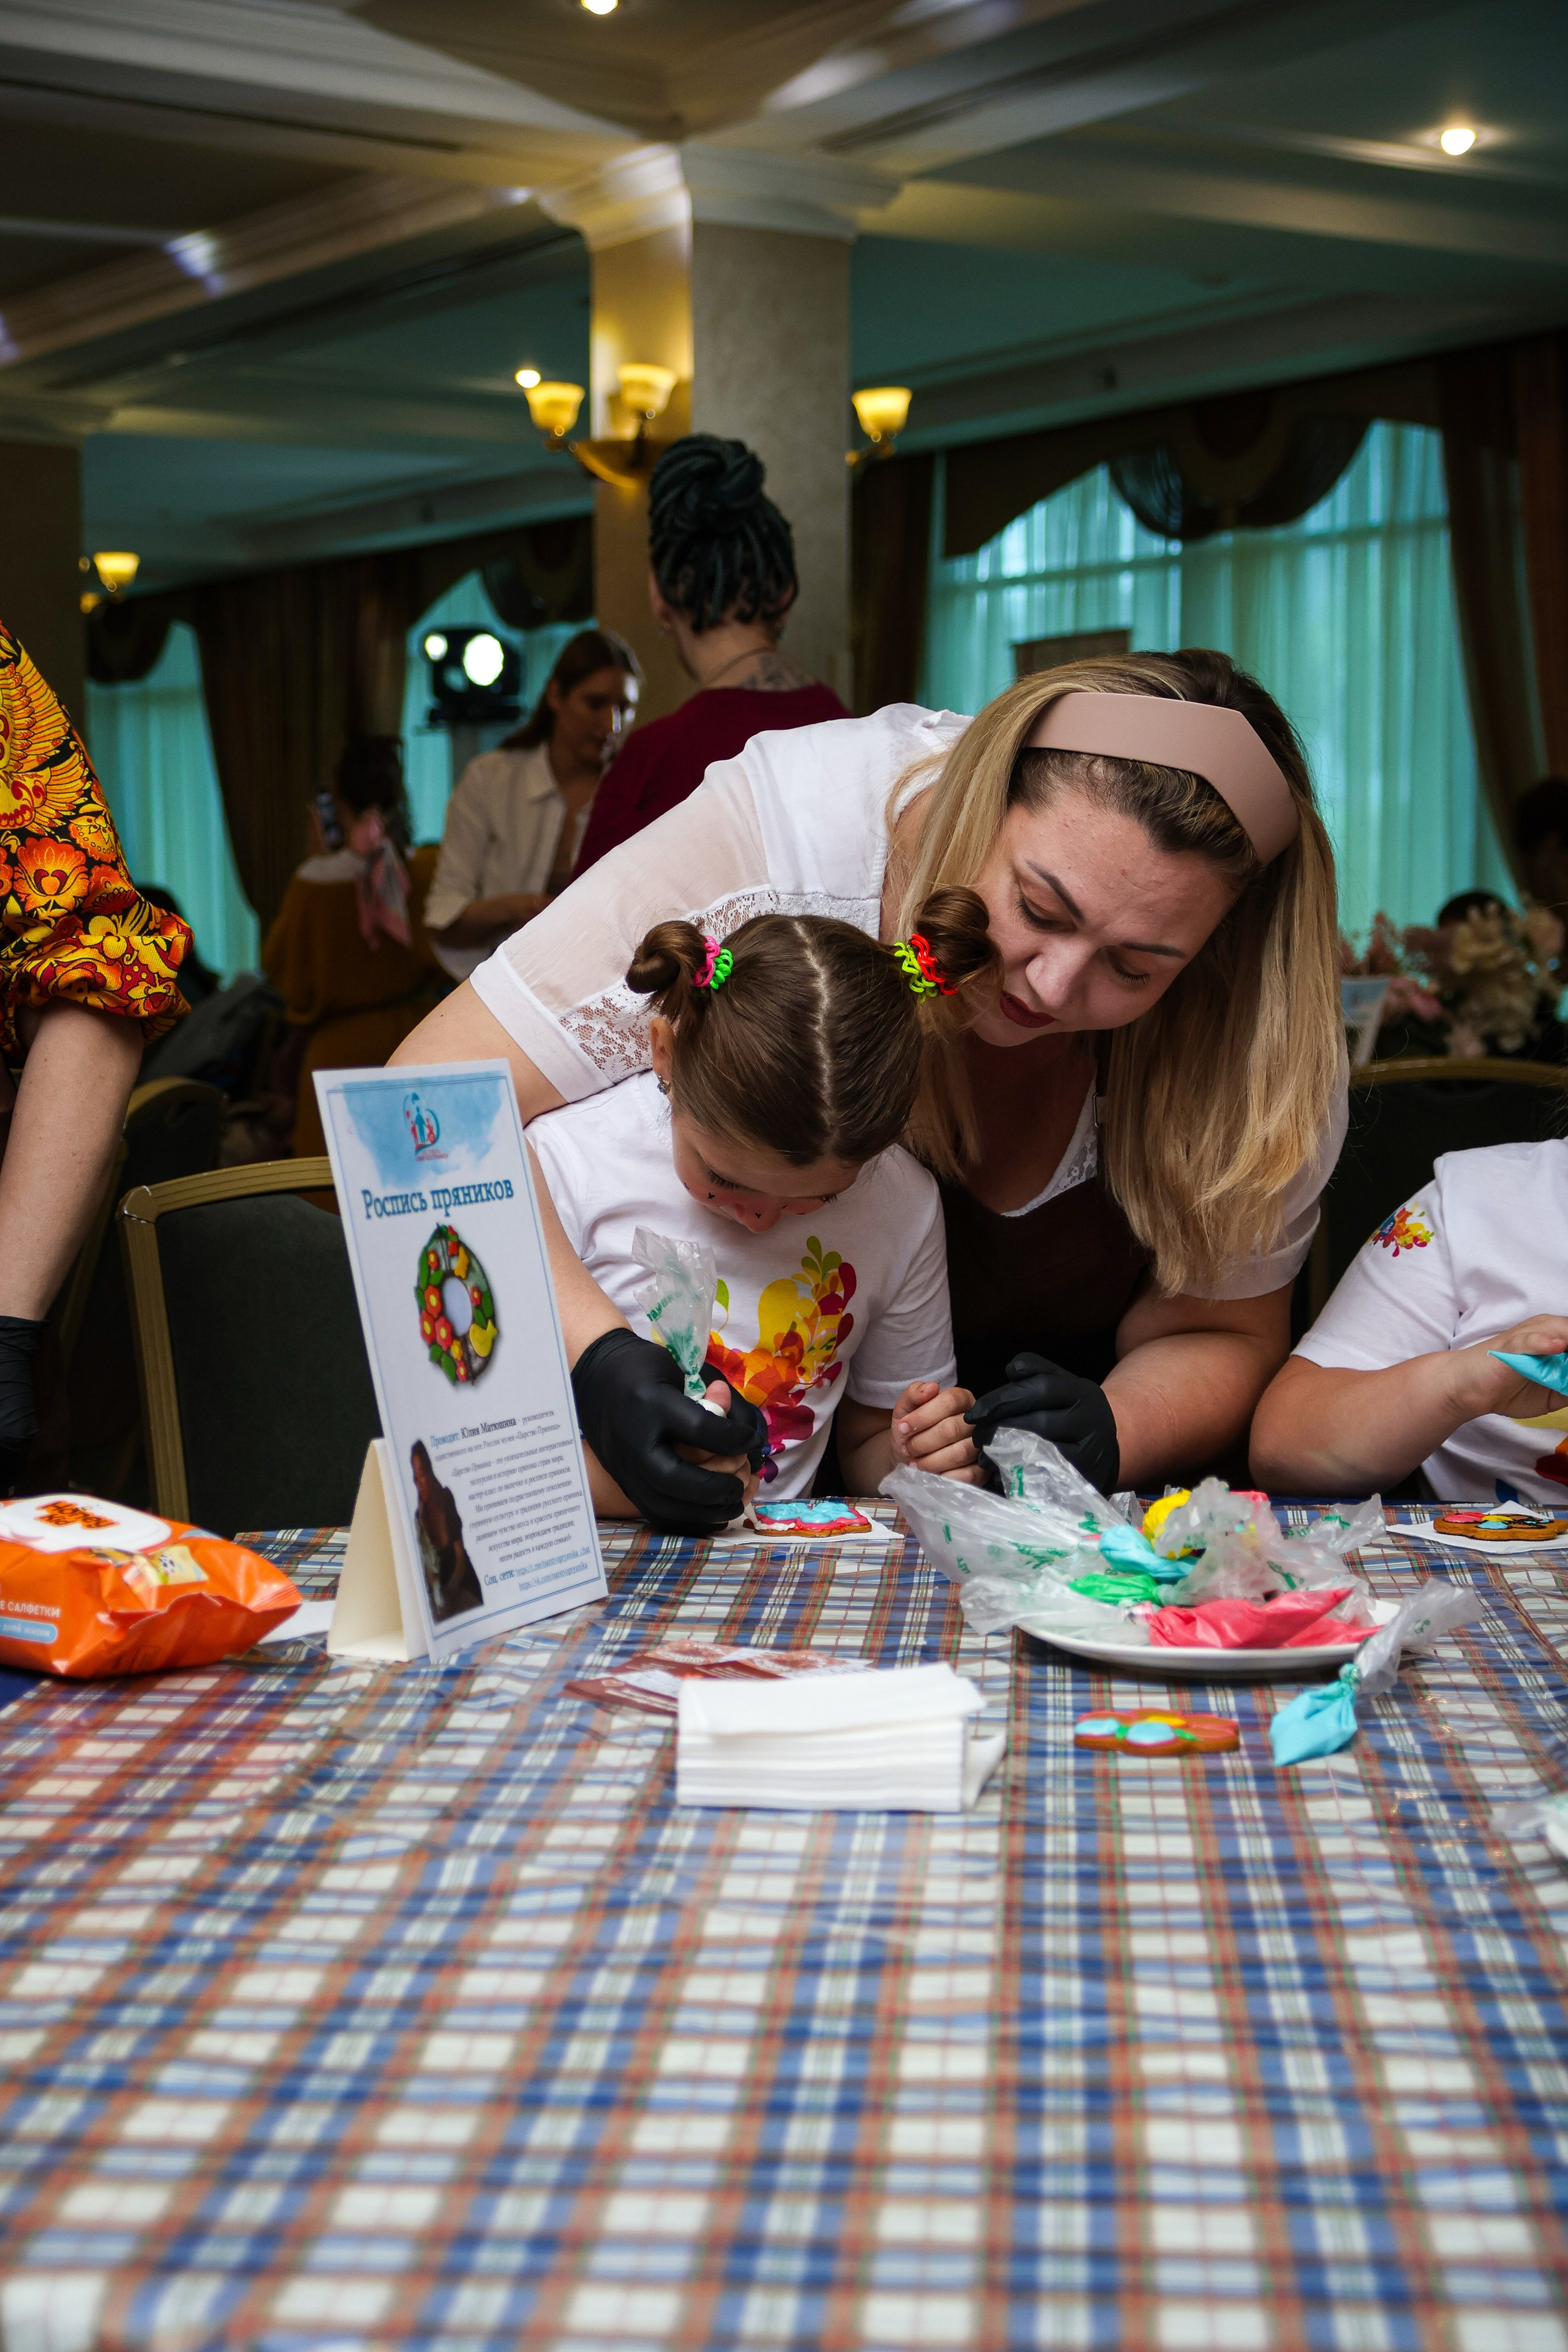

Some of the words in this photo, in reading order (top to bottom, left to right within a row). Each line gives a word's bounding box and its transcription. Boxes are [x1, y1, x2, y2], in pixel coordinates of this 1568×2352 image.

[361, 1189, 427, 1219] Роспись
[430, 1179, 513, 1217] пряников
[461, 1427, 480, 1439] Юлия
[480, 1418, 516, 1434] Матюшина
[522, 1411, 554, 1426] руководитель
[483, 1439, 500, 1449] России
[501, 1436, 514, 1446] музея
[516, 1430, 537, 1440] «Царство
[537, 1424, 560, 1436] Пряника»
[503, 1449, 538, 1464] увлекательные
[539, 1439, 573, 1453] интерактивные
[470, 1474, 492, 1486] экскурсии
[497, 1468, 517, 1478] историю
[518, 1462, 537, 1474] пряника
[538, 1459, 551, 1468] стран
[468, 1488, 496, 1501] мастер-класс
[504, 1480, 524, 1490] выпечке
[529, 1473, 548, 1486] росписи
[475, 1504, 483, 1513] Мы
[484, 1498, 508, 1512] прививаем
[508, 1488, 545, 1503] подрастающему
[546, 1480, 572, 1493] поколению
[494, 1510, 514, 1523] культуру
[519, 1502, 541, 1516] традиции
[542, 1496, 563, 1509] русского
[476, 1530, 497, 1544] развиваем
[498, 1525, 516, 1535] чувство
[516, 1520, 529, 1529] вкуса
[534, 1513, 552, 1525] красоты
[553, 1505, 581, 1519] пряничного
[524, 1527, 551, 1541] возрождаем
[499, 1554, 512, 1562] несем
[513, 1548, 531, 1561] радость
[535, 1540, 554, 1551] каждую
[499, 1569, 515, 1581] сети:
[7, 1602, 61, 1618] САЛФЕТКИ
